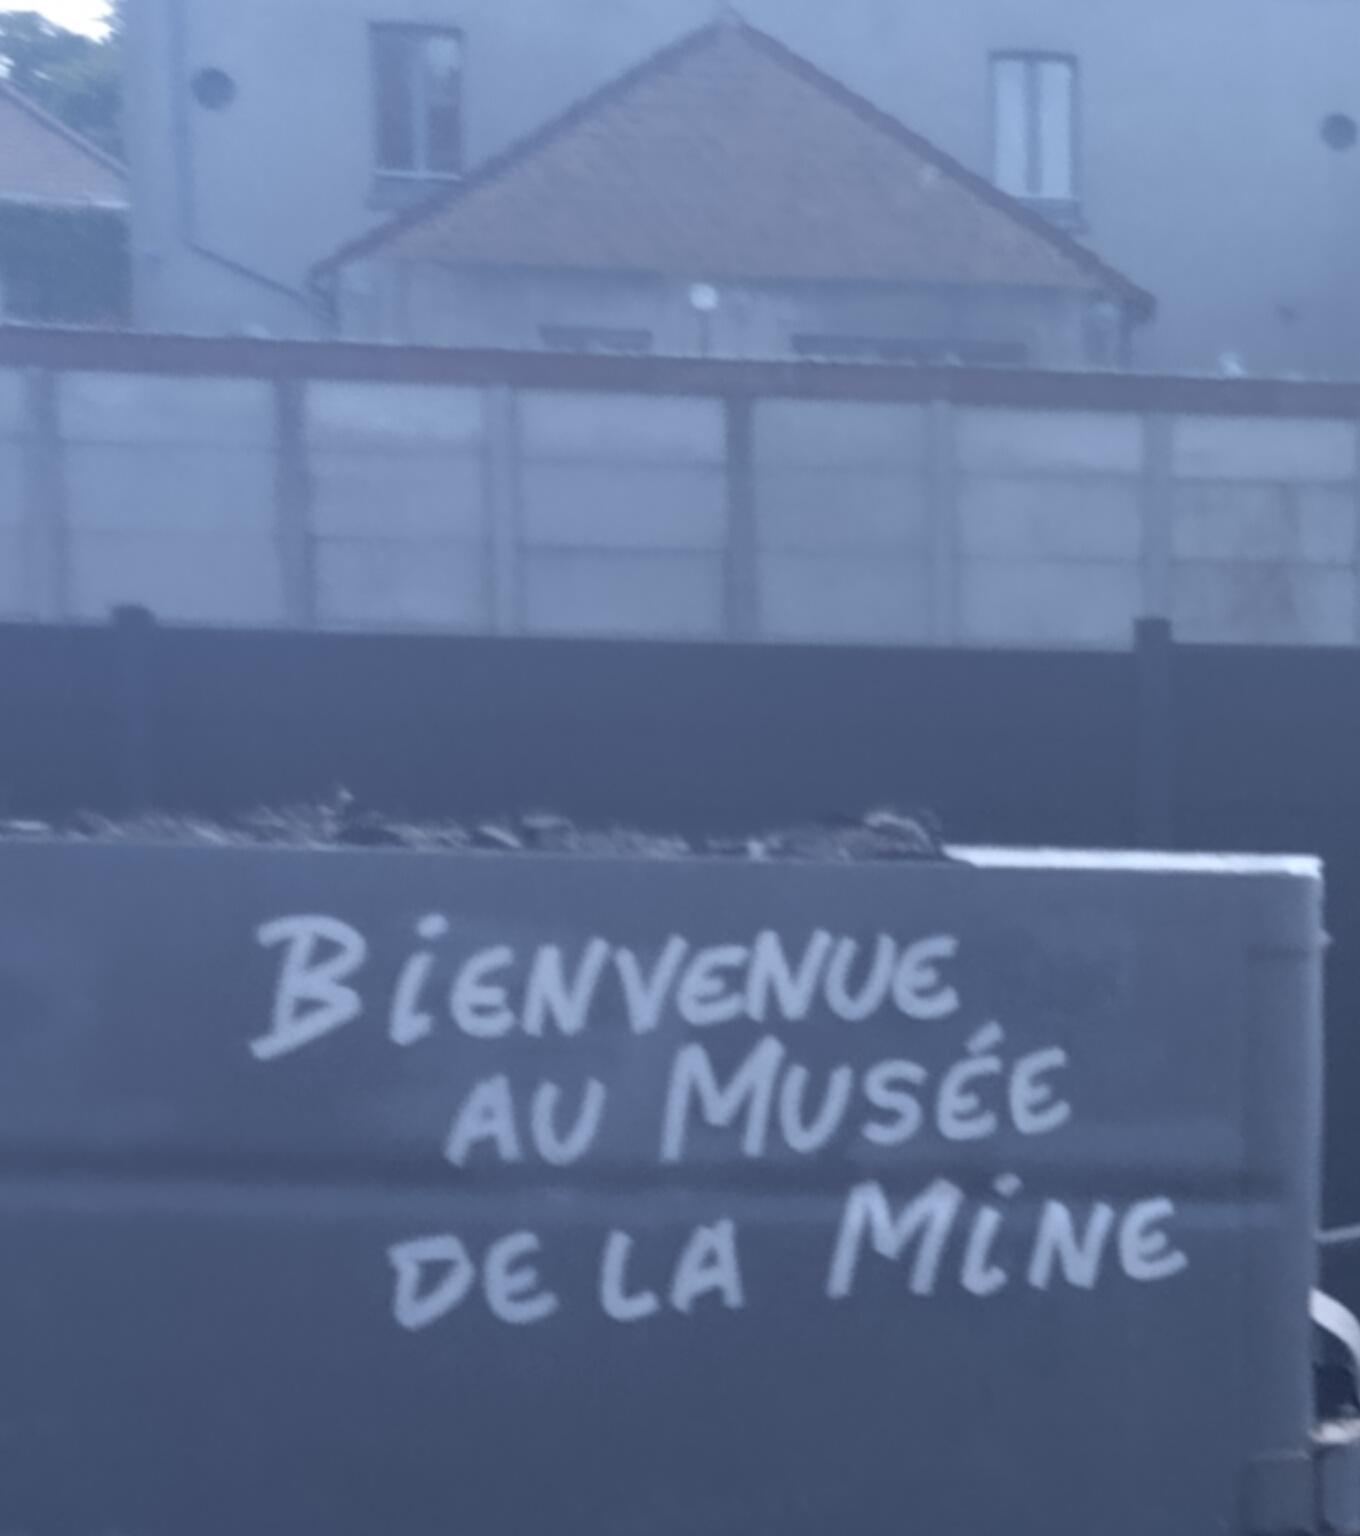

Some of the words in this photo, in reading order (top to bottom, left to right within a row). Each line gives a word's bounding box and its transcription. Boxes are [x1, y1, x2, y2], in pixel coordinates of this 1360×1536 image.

[446, 1074, 606, 1165] AU
[661, 1021, 1072, 1161] MUSÉE
[386, 1230, 559, 1331] DE
[600, 1217, 744, 1322] LA
